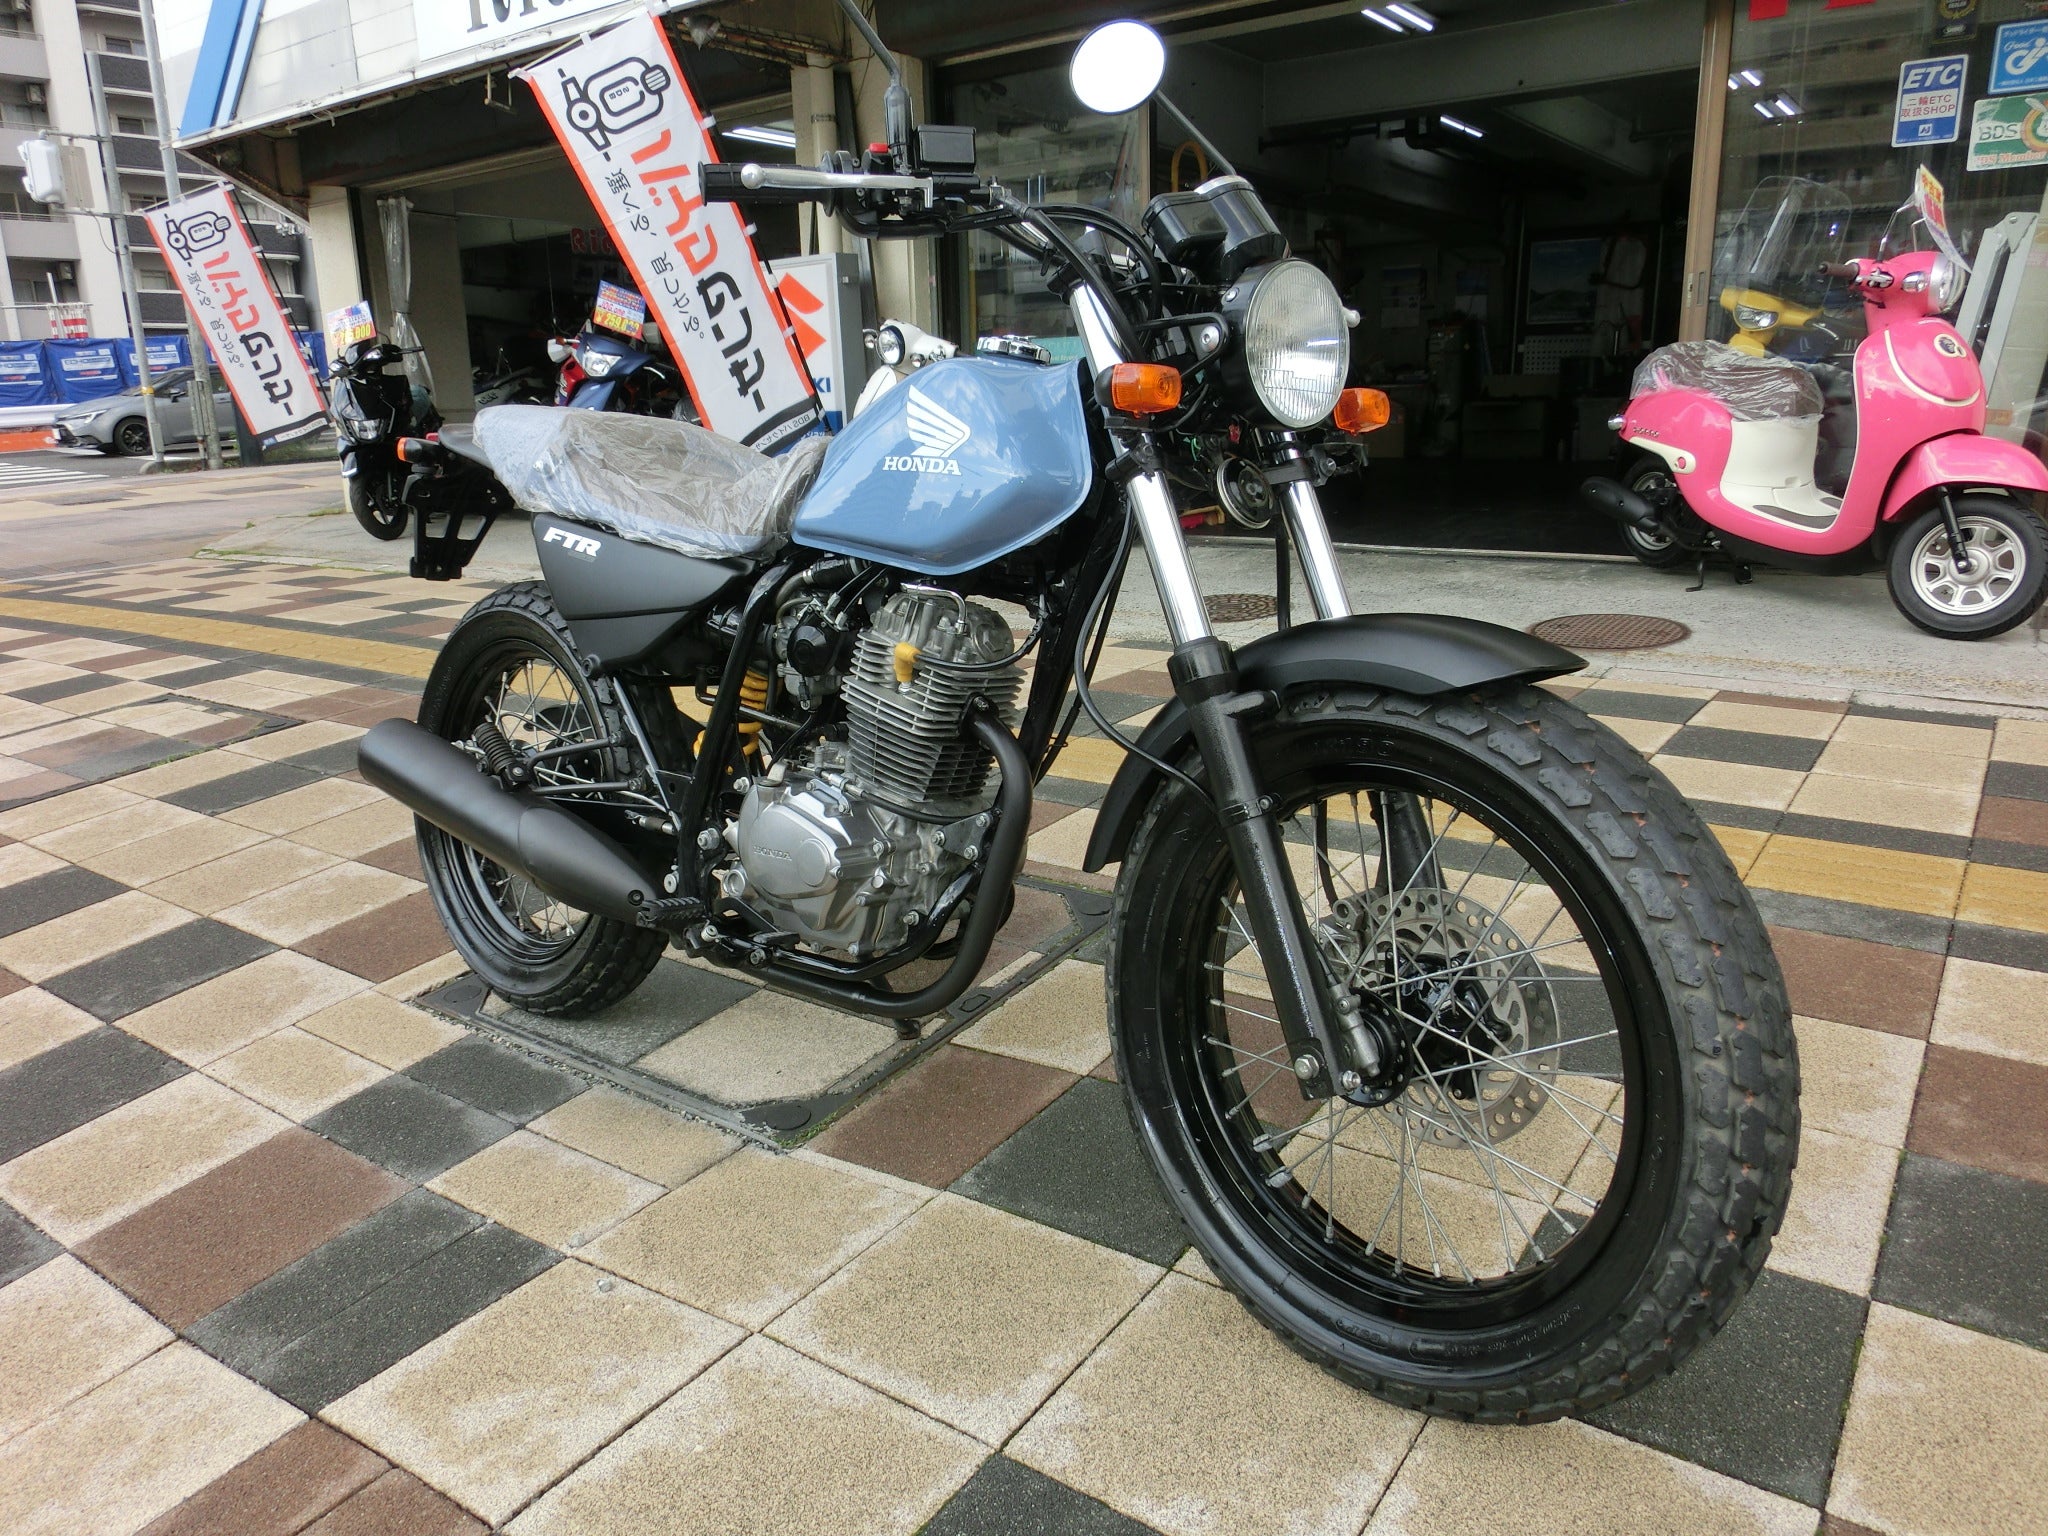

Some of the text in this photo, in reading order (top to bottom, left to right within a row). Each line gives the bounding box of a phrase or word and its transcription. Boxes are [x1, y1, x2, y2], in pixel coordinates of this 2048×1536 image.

[1903, 63, 1962, 90] ETC
[1908, 94, 1952, 106] 二輪ETC
[1901, 104, 1955, 117] 取扱SHOP
[1979, 124, 2018, 140] BDS
[882, 456, 962, 476] HONDA
[543, 526, 601, 557] FTR
